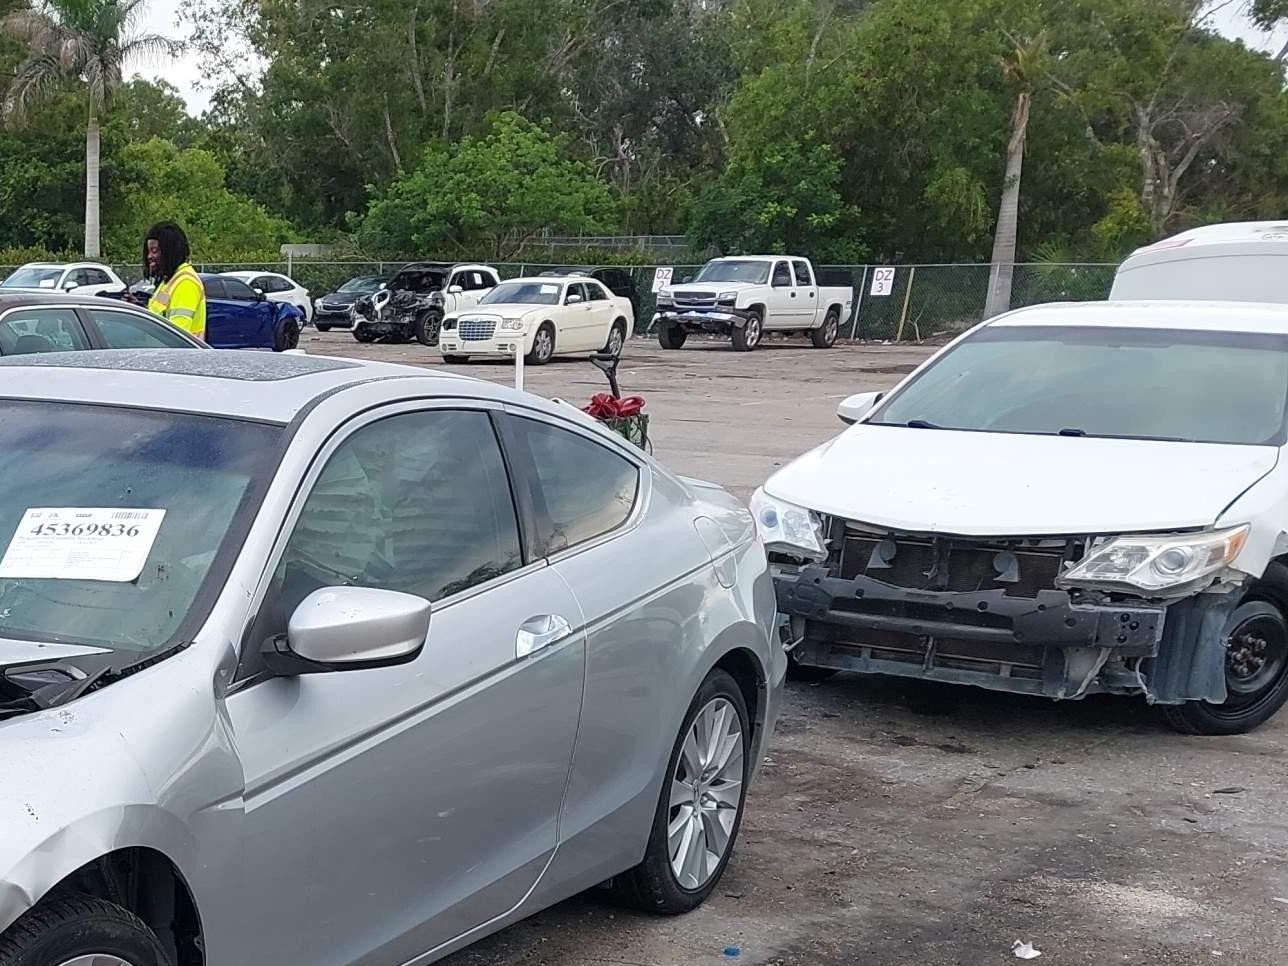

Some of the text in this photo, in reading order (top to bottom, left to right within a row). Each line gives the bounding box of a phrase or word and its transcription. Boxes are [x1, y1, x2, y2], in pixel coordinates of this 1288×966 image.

[656, 268, 672, 280] DZ
[875, 269, 893, 281] DZ
[658, 280, 665, 291] 2
[877, 282, 884, 293] 3
[29, 522, 142, 537] 45369836
